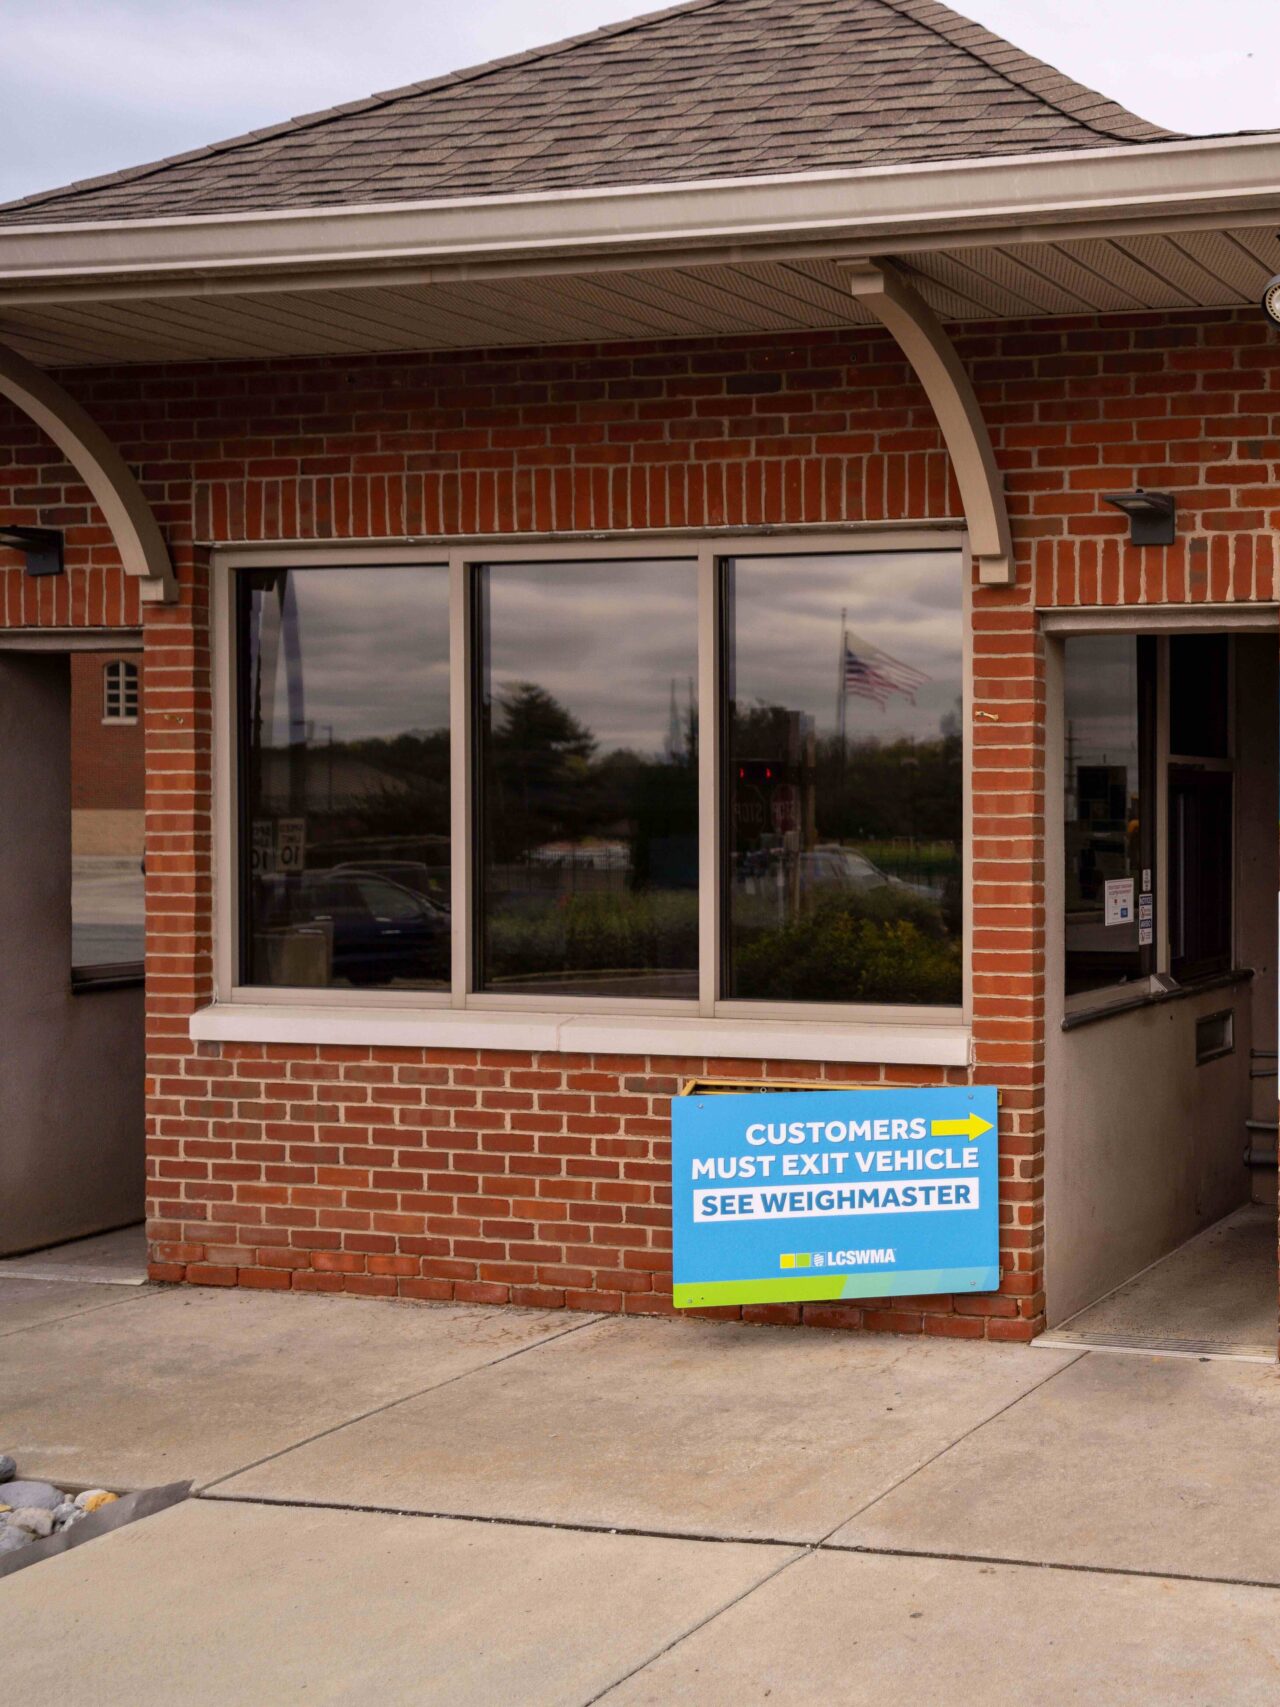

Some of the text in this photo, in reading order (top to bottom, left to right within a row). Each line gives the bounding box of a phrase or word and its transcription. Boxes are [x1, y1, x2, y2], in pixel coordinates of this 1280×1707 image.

[745, 1117, 927, 1146] CUSTOMERS
[691, 1147, 979, 1181] MUST EXIT VEHICLE
[701, 1184, 971, 1217] SEE WEIGHMASTER
[827, 1248, 896, 1266] LCSWMA
